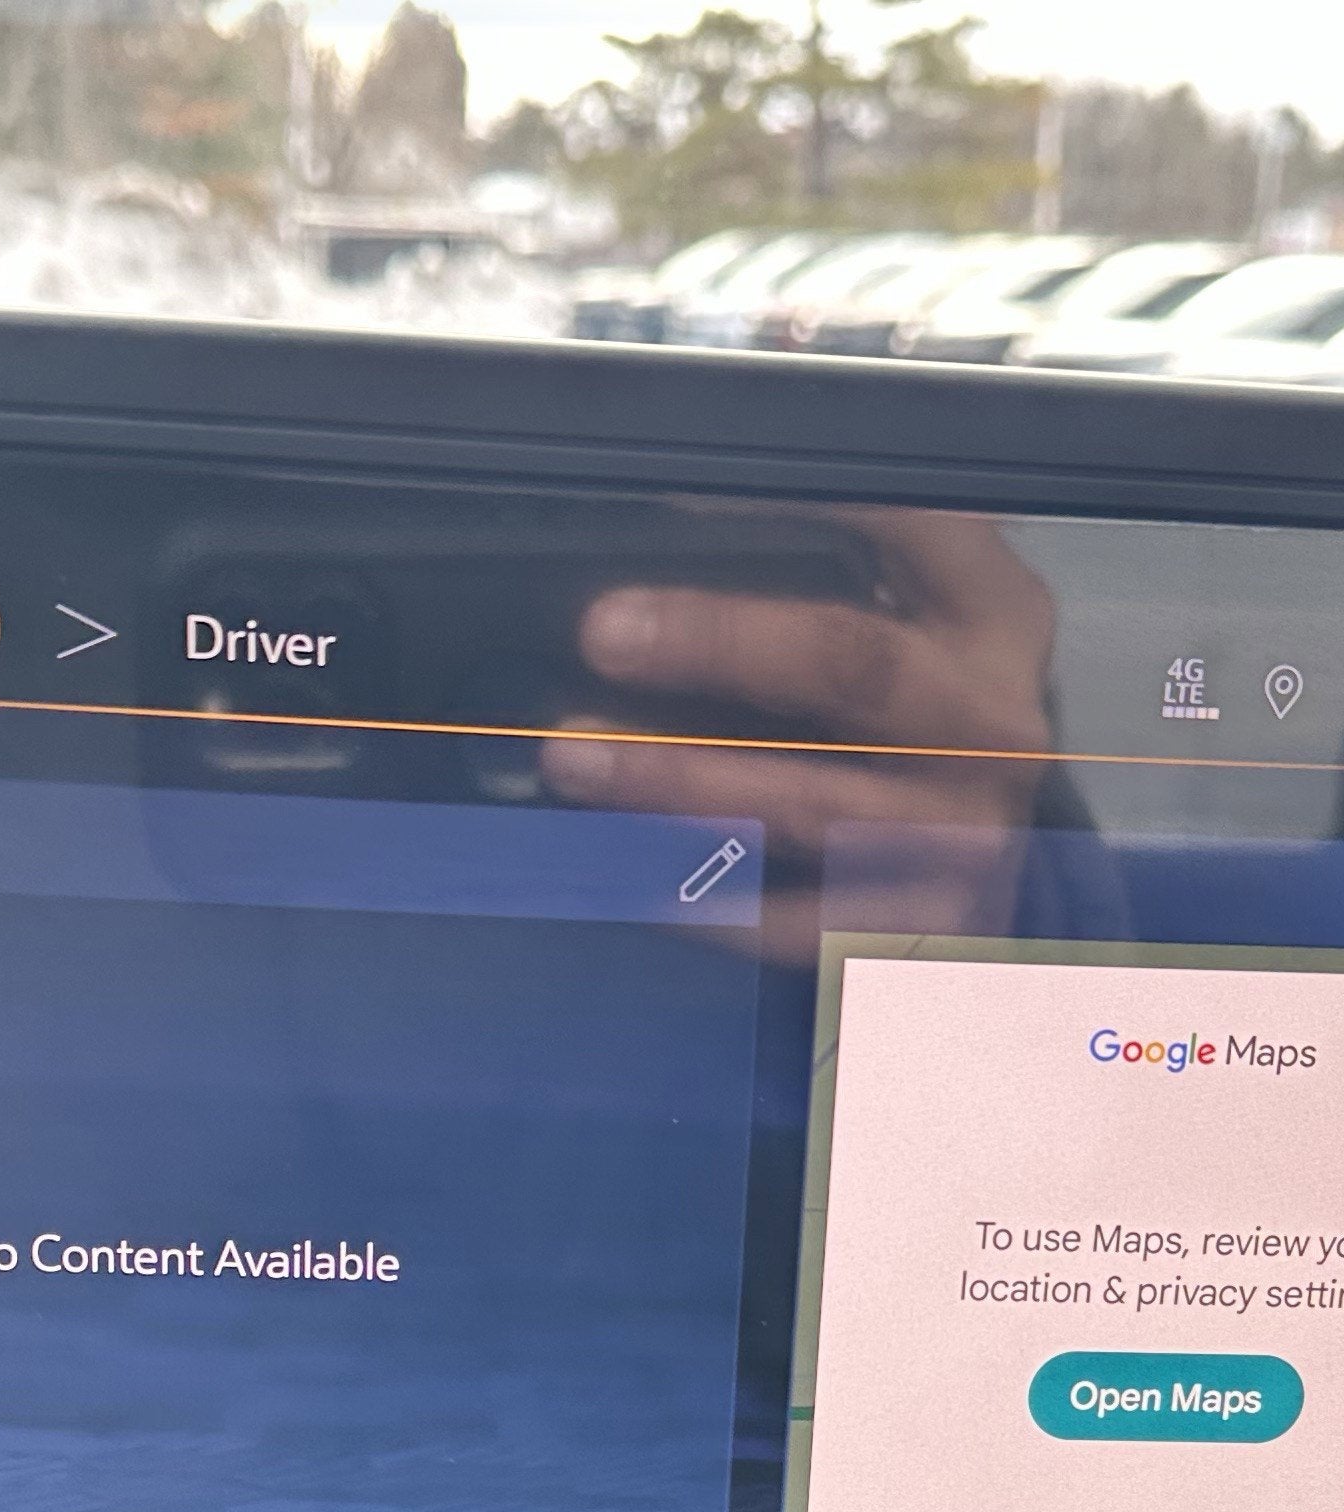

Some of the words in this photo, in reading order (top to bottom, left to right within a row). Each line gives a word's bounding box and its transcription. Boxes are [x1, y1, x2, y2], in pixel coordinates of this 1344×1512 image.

[185, 614, 337, 668] Driver
[1167, 658, 1205, 682] 4G
[1163, 683, 1204, 704] LTE
[1089, 1029, 1216, 1072] Google
[1225, 1036, 1317, 1074] Maps
[31, 1234, 204, 1276] Content
[214, 1239, 401, 1282] Available
[976, 1221, 1012, 1252] To
[1022, 1230, 1082, 1253] use
[1092, 1225, 1191, 1260] Maps,
[1202, 1226, 1310, 1257] review
[960, 1271, 1092, 1304] location
[1102, 1276, 1127, 1305] &
[1136, 1276, 1256, 1314] privacy
[1069, 1381, 1162, 1417] Open
[1170, 1383, 1262, 1420] Maps
